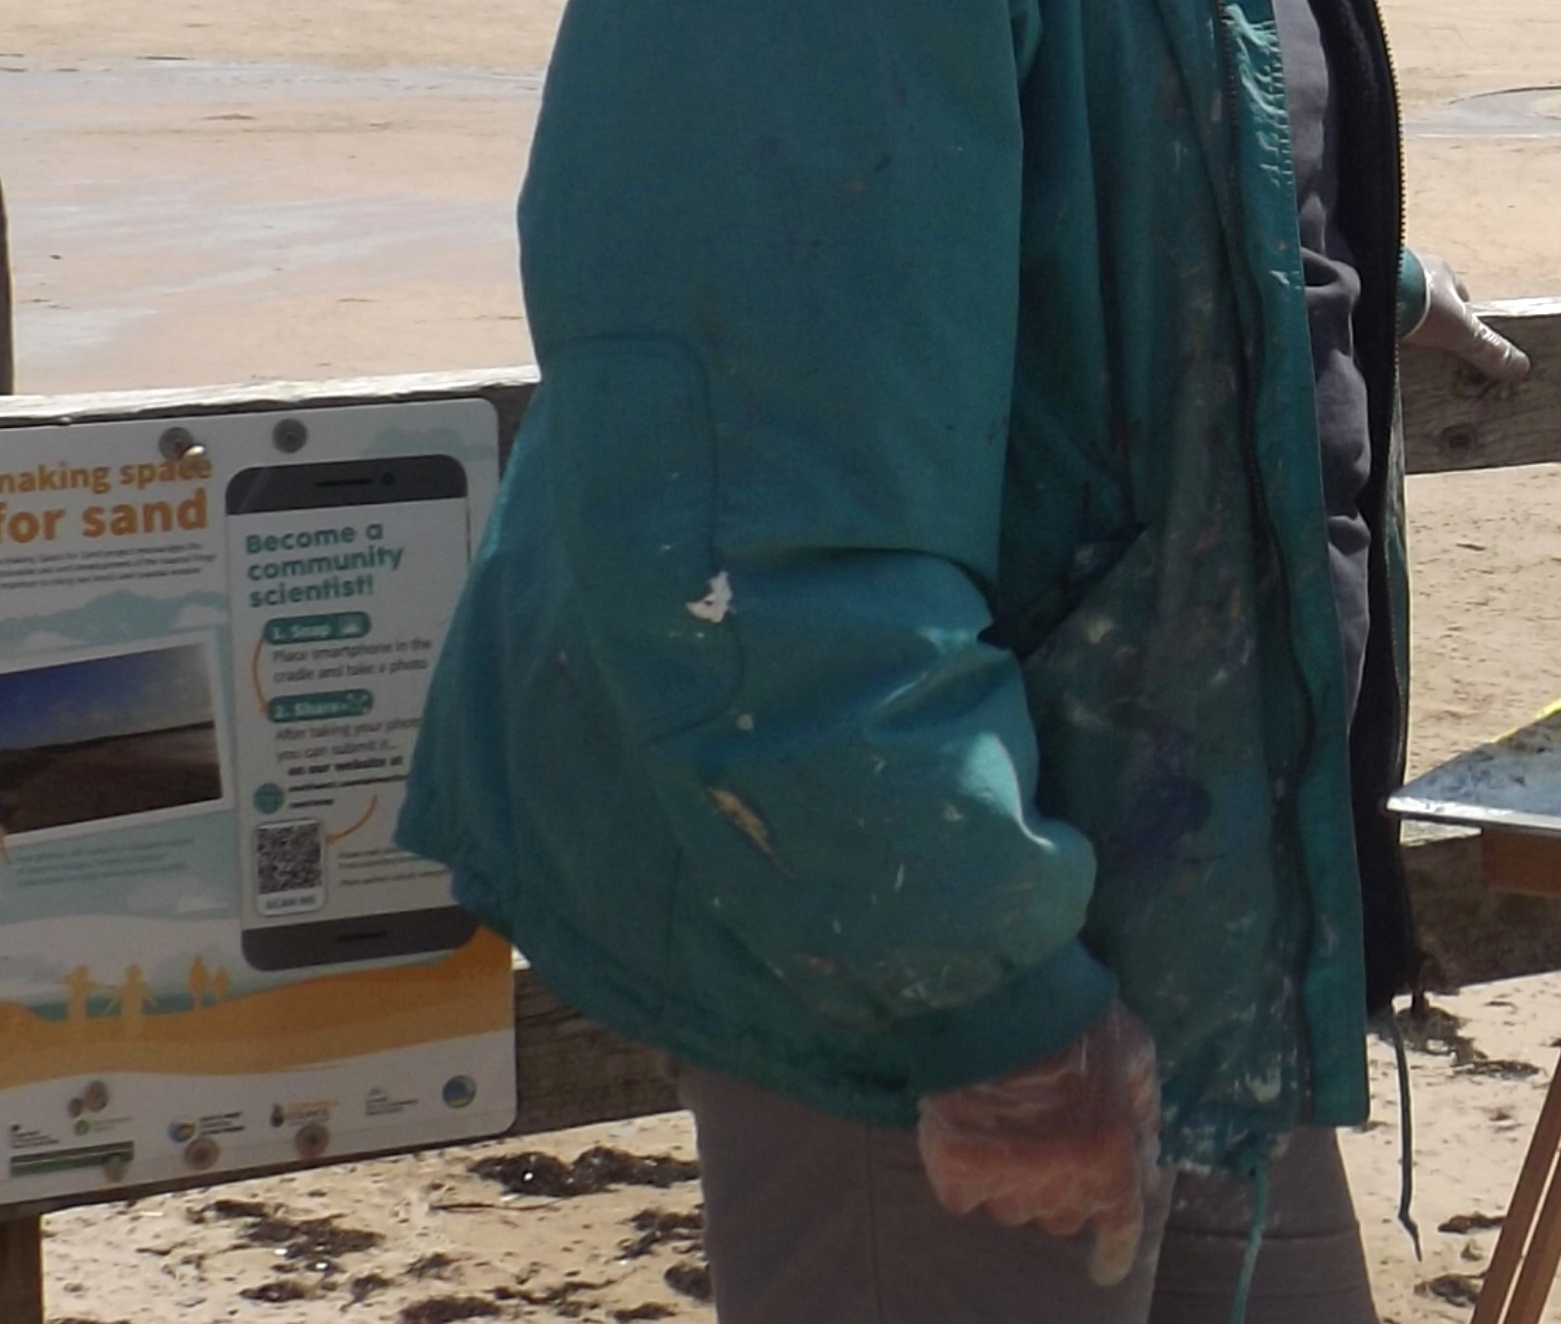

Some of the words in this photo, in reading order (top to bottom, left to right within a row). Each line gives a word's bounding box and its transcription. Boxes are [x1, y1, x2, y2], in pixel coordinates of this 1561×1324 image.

[82, 487, 206, 537] sand
[246, 526, 356, 554] Become
[366, 523, 383, 540] a
[248, 545, 403, 580] community
[250, 574, 374, 608] scientist!
